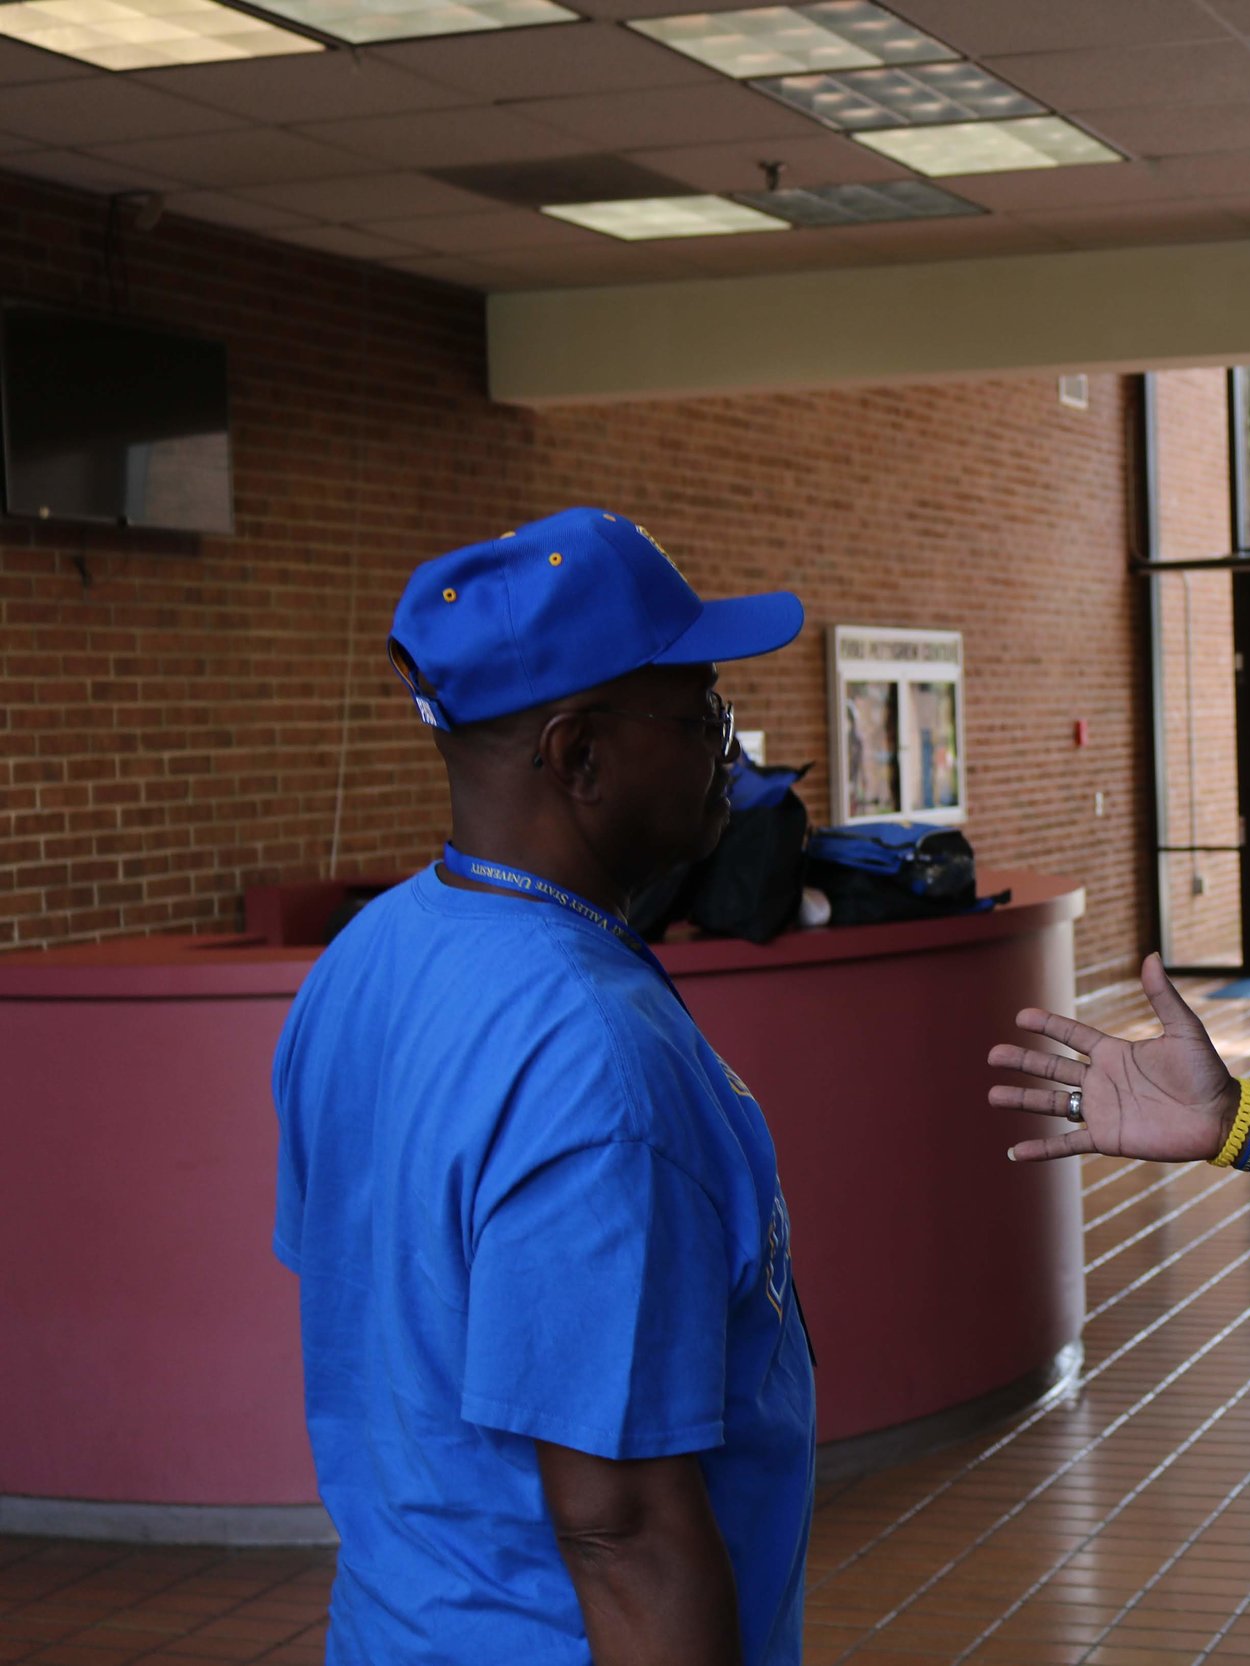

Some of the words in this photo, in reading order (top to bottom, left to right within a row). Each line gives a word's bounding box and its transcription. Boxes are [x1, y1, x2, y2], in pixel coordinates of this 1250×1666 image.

[470, 862, 532, 890] UNIVERSITY
[535, 880, 569, 906] STATE
[570, 896, 608, 930] VALLEY
